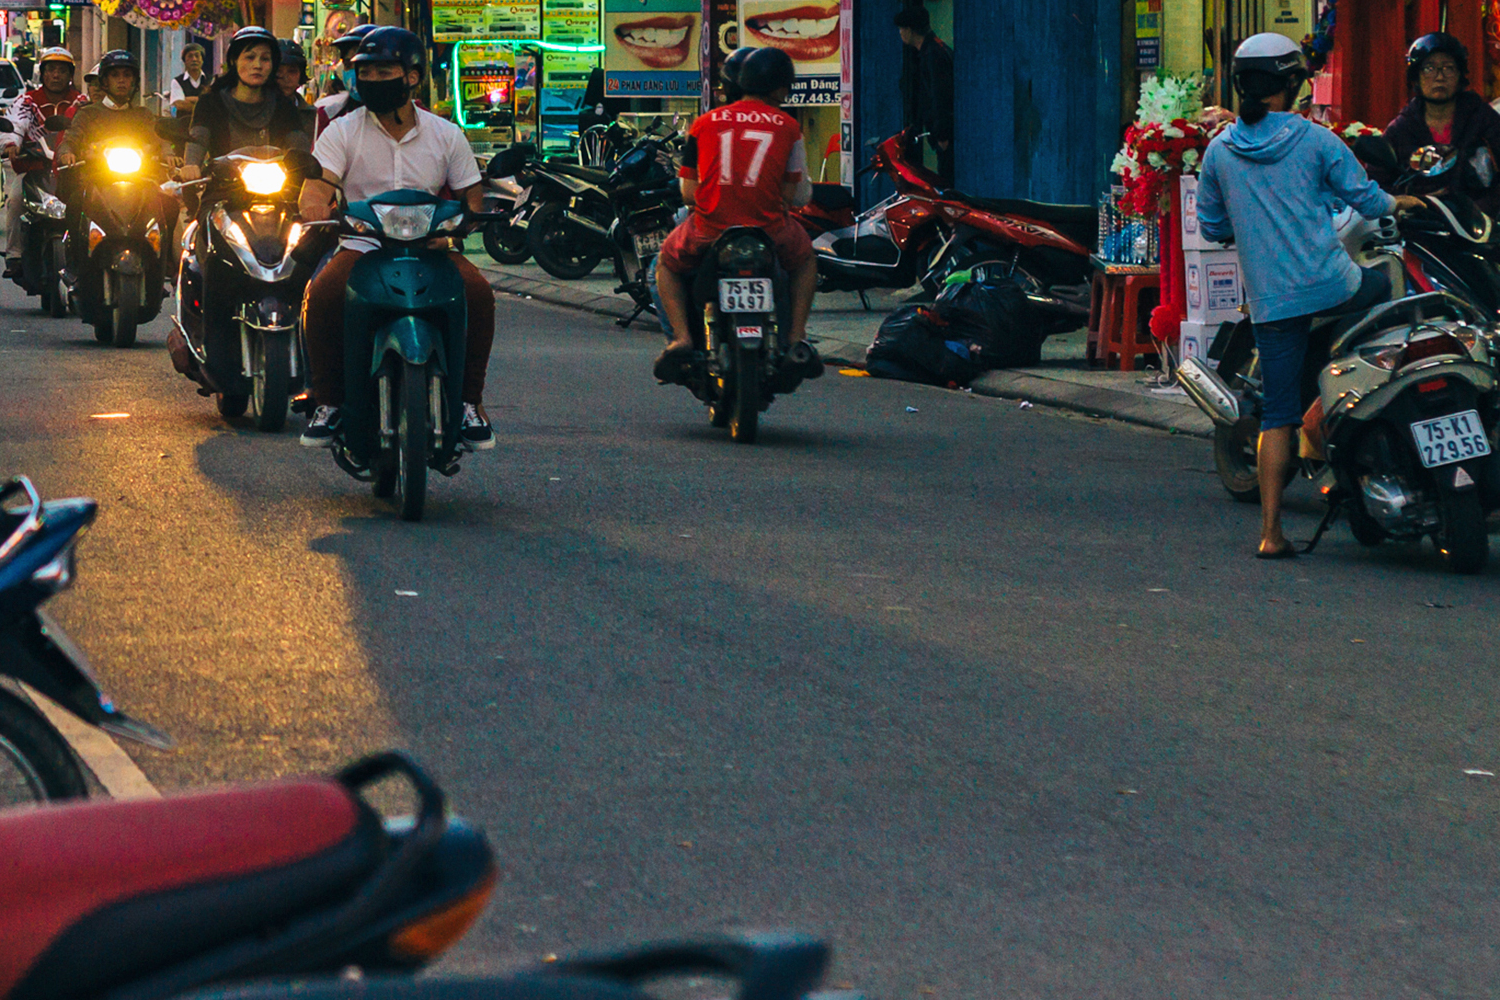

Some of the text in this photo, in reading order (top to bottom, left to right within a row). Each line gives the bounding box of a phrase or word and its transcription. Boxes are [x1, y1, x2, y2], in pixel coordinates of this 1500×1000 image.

[608, 78, 619, 91] 24
[621, 80, 643, 90] PHAN
[711, 110, 732, 122] LÊ
[717, 129, 774, 187] 17
[728, 296, 765, 309] 9497
[1422, 416, 1472, 443] 75-K1
[1424, 439, 1487, 467] 229.56
